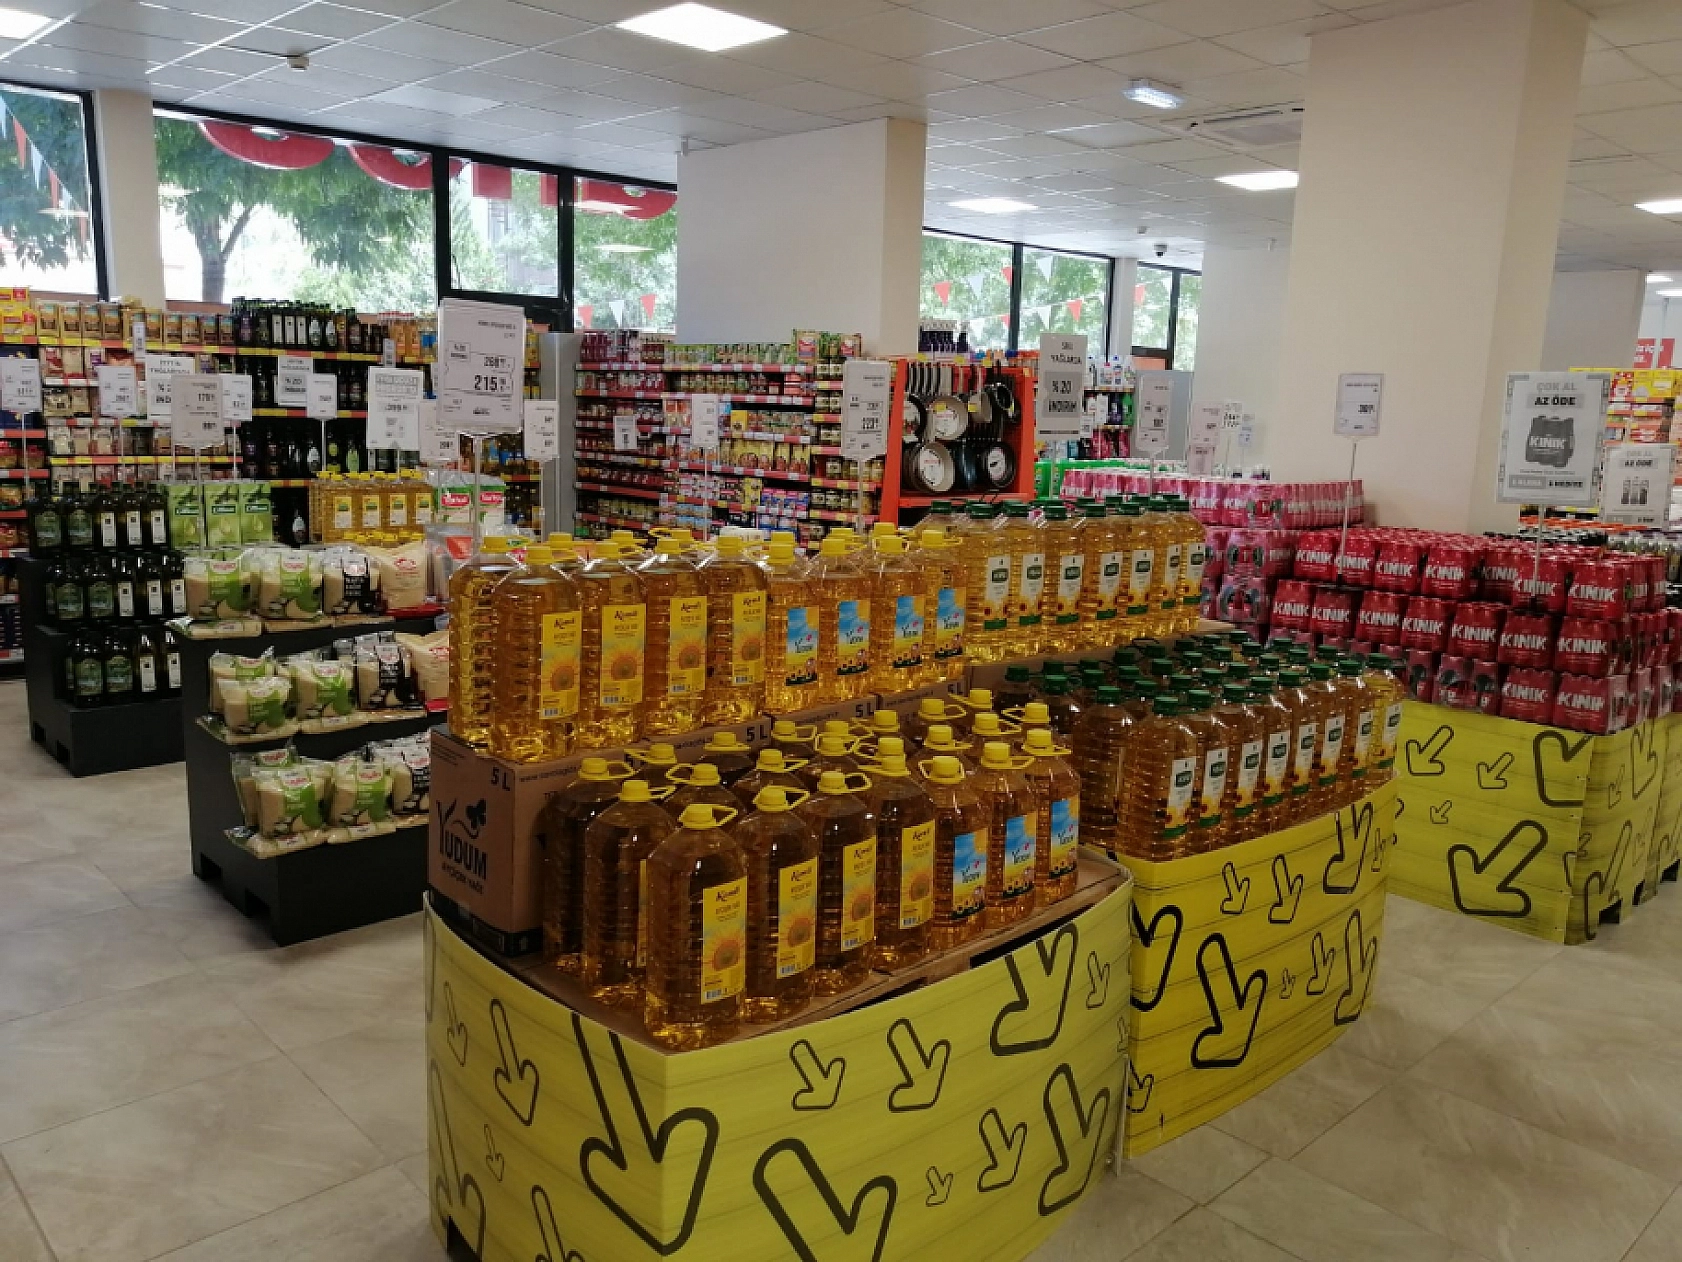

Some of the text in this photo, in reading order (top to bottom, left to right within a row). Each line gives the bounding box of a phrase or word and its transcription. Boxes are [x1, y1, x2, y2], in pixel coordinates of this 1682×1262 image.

[474, 374, 498, 392] 215
[1535, 395, 1576, 406] AZ ÖDE
[1529, 435, 1567, 449] KINIK
[1296, 550, 1333, 565] KINIK
[1376, 562, 1413, 577] KINIK
[1426, 565, 1464, 580] KINIK
[1568, 584, 1618, 603] KINIK
[1273, 602, 1310, 616] KINIK
[1312, 606, 1350, 623] KINIK
[1360, 610, 1400, 626] KINIK
[1402, 617, 1443, 635] KINIK
[1452, 624, 1497, 642] KINIK
[1502, 633, 1548, 651] KINIK
[1558, 638, 1607, 655] KINIK
[1502, 683, 1548, 703] KINIK
[1557, 692, 1604, 711] KINIK
[855, 703, 865, 718] 5
[746, 724, 769, 742] 5 L
[491, 767, 511, 792] 5 L
[436, 798, 488, 880] YUDUM
